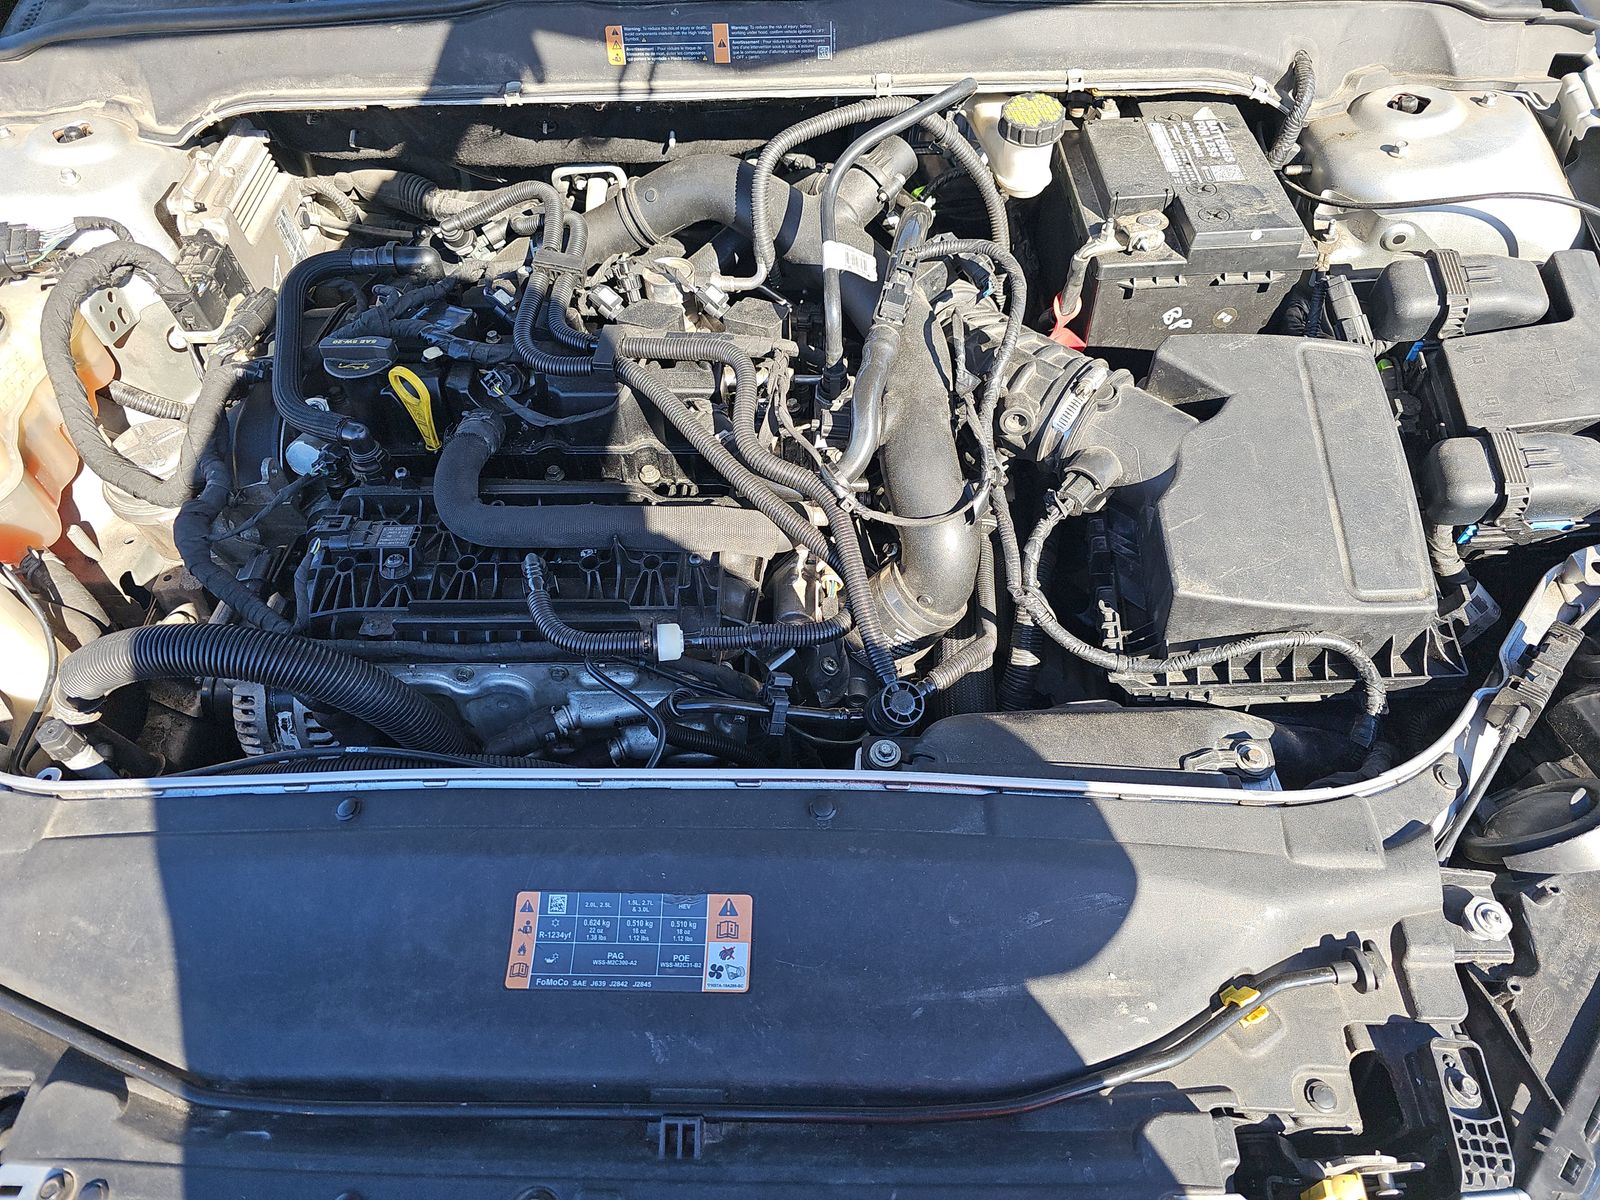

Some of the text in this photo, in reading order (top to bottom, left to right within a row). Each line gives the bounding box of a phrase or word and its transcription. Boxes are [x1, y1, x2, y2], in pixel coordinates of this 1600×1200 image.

[602, 920, 610, 928] kg
[645, 920, 654, 928] kg
[539, 932, 572, 940] R-1234yf
